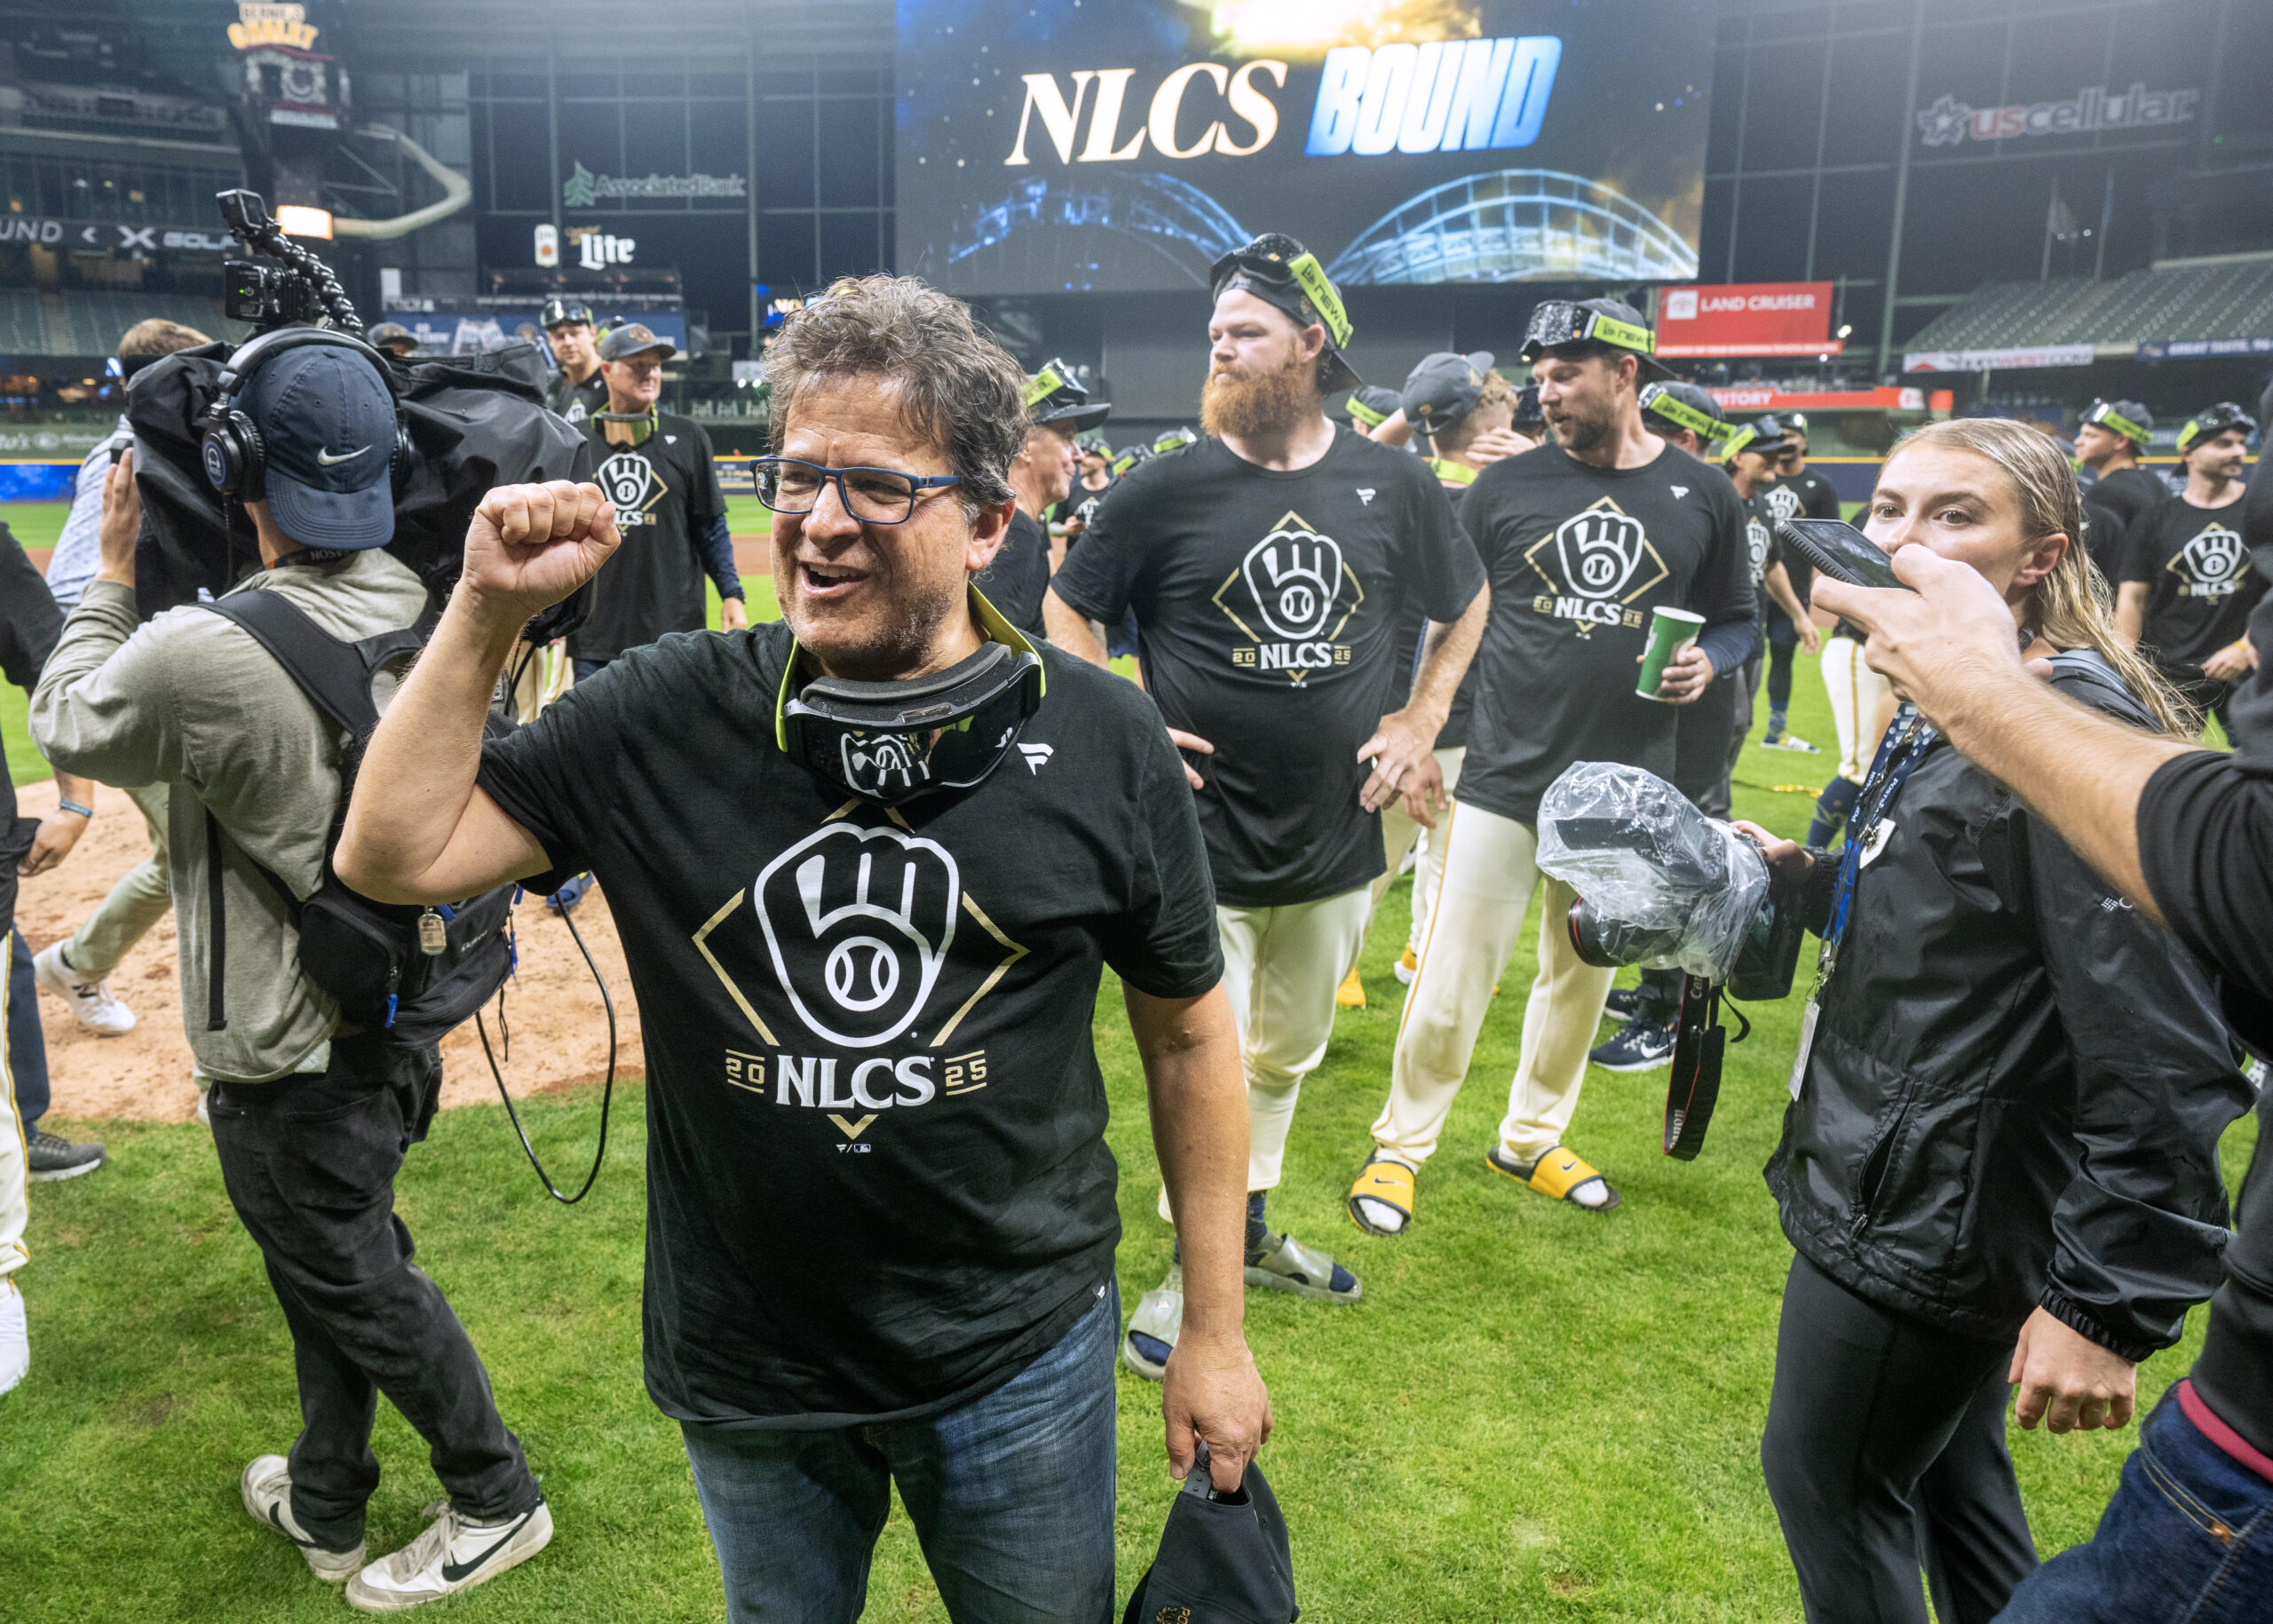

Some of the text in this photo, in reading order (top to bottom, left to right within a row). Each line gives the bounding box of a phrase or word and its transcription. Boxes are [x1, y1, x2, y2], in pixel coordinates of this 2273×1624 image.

[1004, 35, 1563, 166] NLCS BOUND
[579, 234, 636, 271] Lite
[1700, 294, 1815, 313] LAND CRUISER
[614, 511, 645, 526] LCS
[1554, 596, 1623, 626] NLCS
[1232, 650, 1255, 664] 20
[1259, 642, 1333, 669] NLCS
[725, 1054, 987, 1109] 20 NLCS 25
